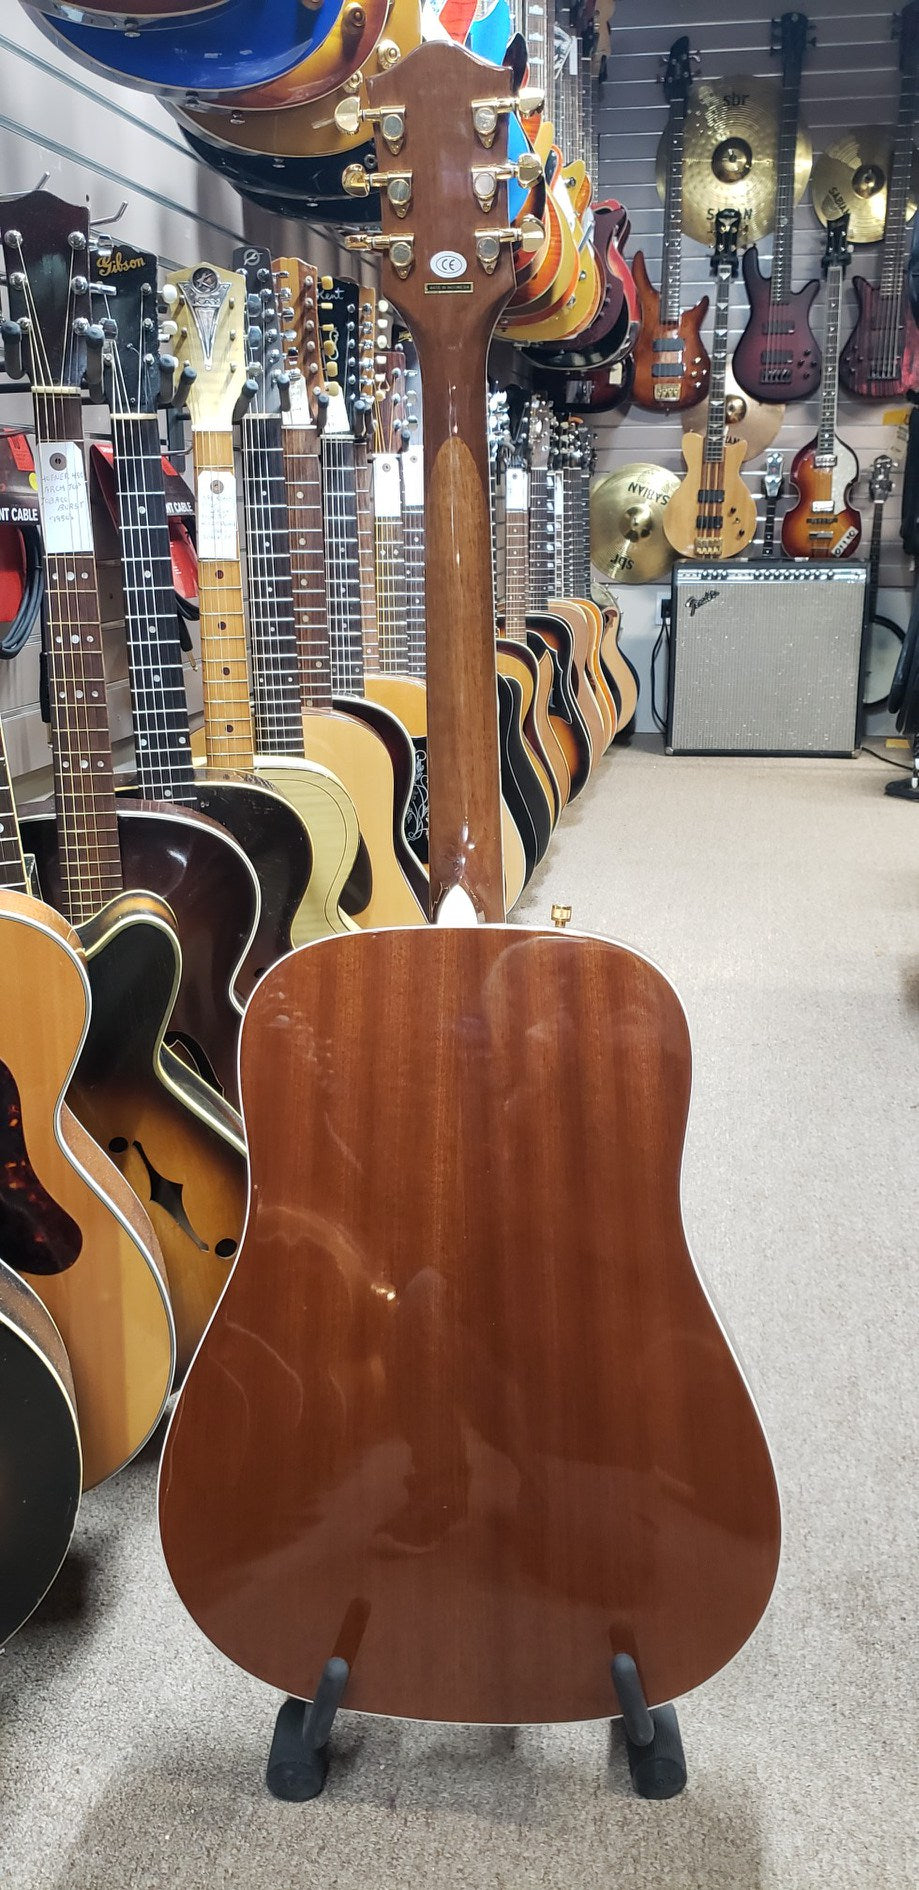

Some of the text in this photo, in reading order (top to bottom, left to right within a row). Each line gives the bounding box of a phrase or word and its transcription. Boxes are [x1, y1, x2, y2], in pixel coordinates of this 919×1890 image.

[723, 92, 750, 106] sbr
[96, 251, 146, 277] Gibson
[441, 258, 456, 271] CE
[317, 287, 345, 300] Kent
[628, 480, 671, 507] SABIAN
[11, 507, 39, 521] CABLE
[174, 502, 193, 513] CABLE
[610, 553, 635, 571] sbr
